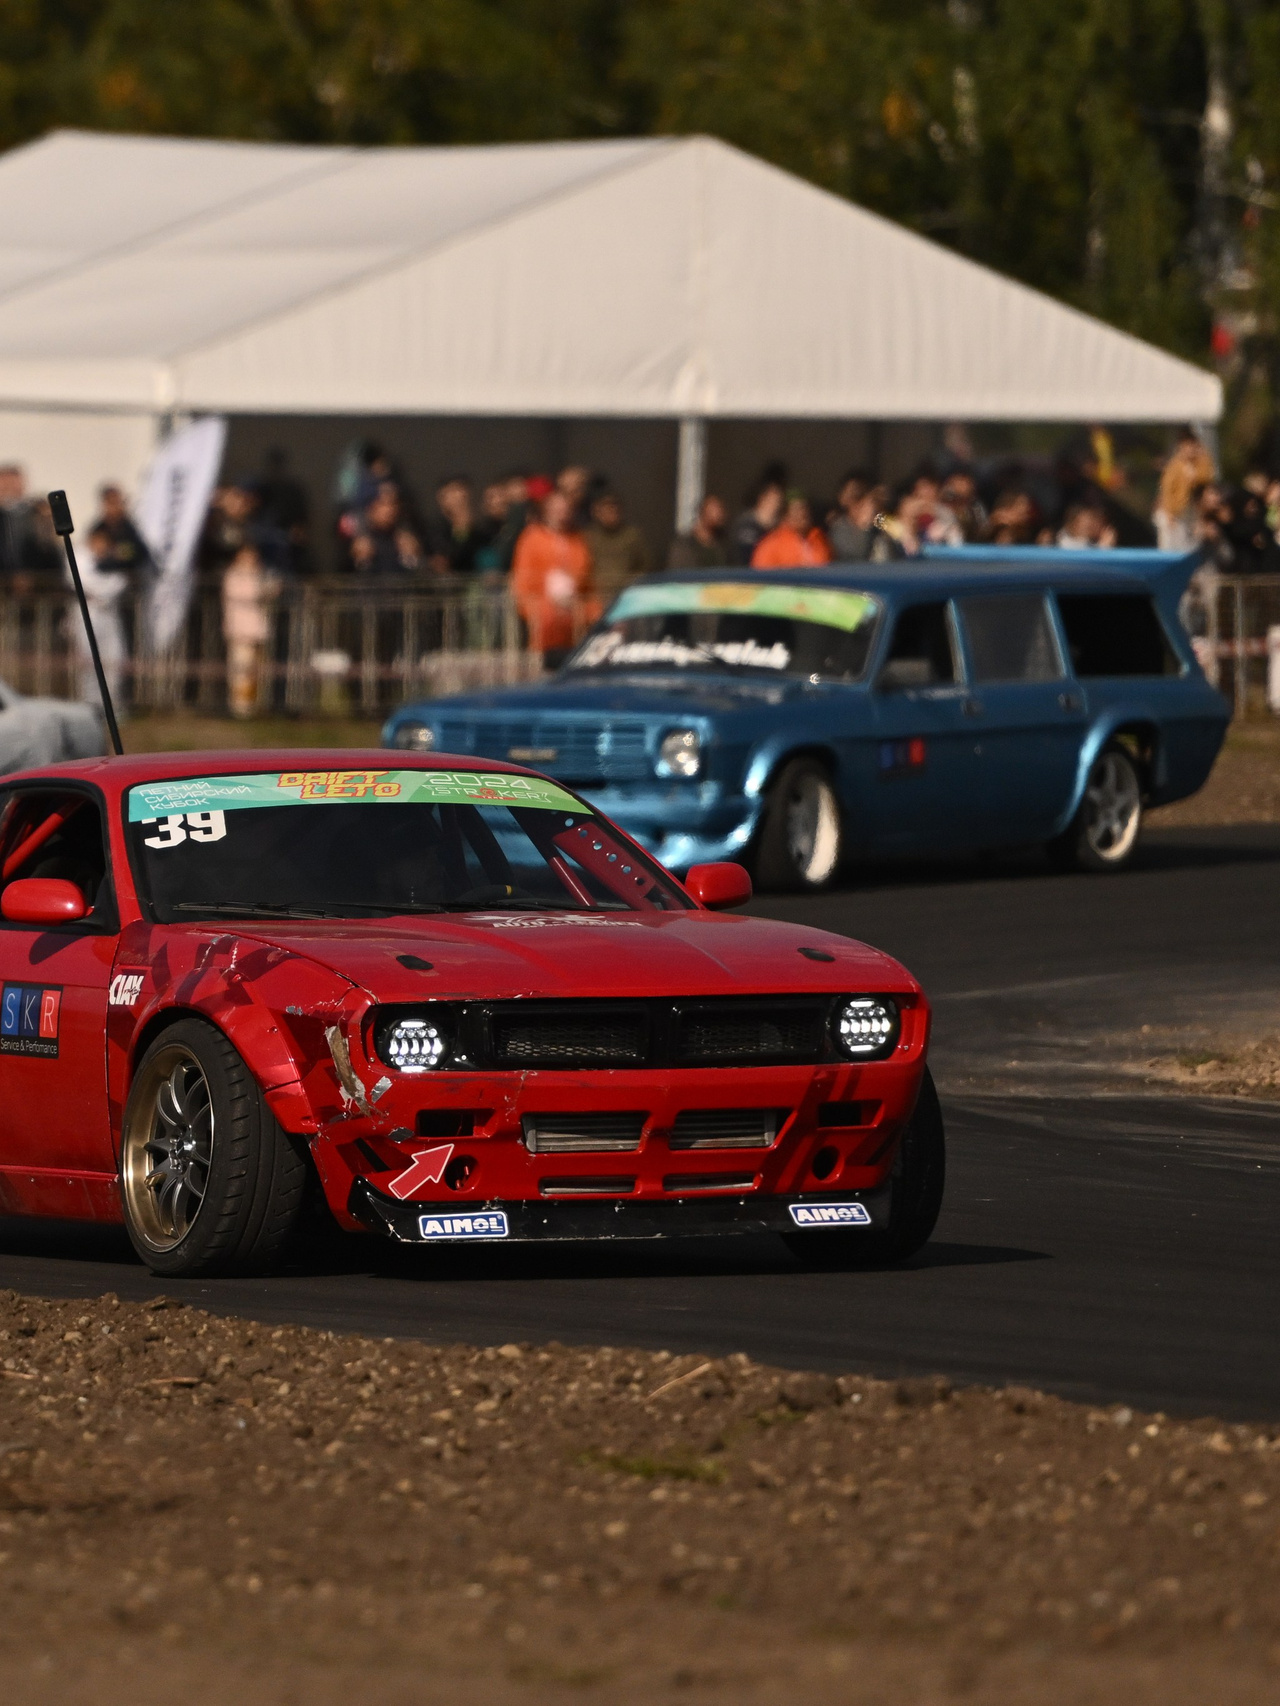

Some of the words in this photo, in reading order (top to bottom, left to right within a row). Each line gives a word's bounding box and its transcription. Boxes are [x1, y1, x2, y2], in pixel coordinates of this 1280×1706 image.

[277, 771, 390, 787] DRIFT
[425, 773, 532, 790] 2024
[144, 785, 252, 804] СИБИРСКИЙ
[300, 783, 401, 799] LETO
[149, 797, 210, 811] КУБОК
[141, 809, 227, 849] 39
[4, 992, 55, 1033] SKR
[0, 1037, 19, 1051] Service
[20, 1039, 26, 1051] &
[797, 1207, 866, 1222] AIMOL
[424, 1217, 504, 1234] AIMOL
